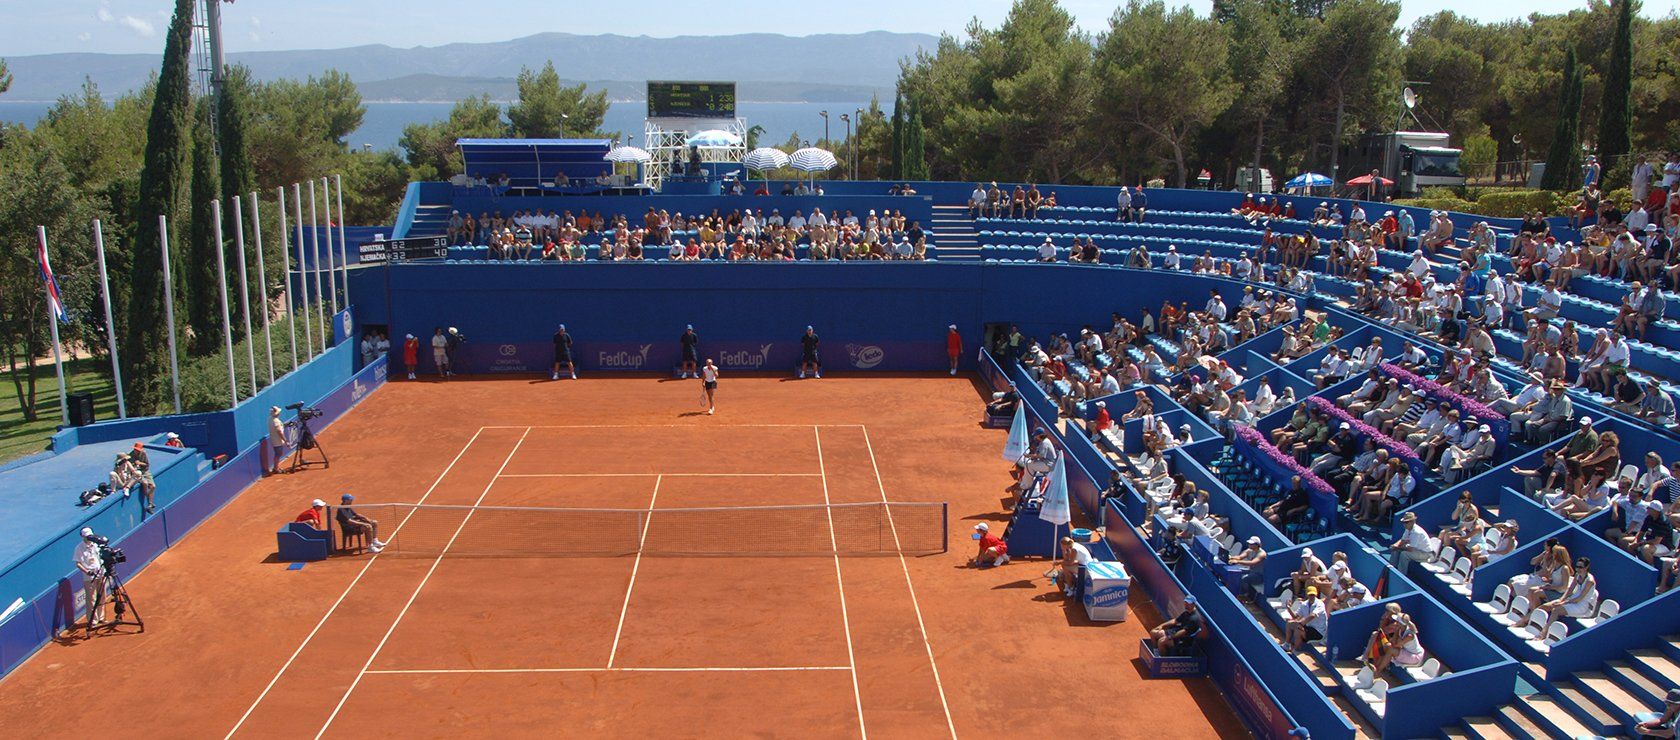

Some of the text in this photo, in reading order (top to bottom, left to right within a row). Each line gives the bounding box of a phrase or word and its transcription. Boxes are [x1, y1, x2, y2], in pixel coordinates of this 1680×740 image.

[600, 351, 642, 368] FedCup
[720, 351, 763, 368] FedCup
[1092, 589, 1128, 605] Jamnica
